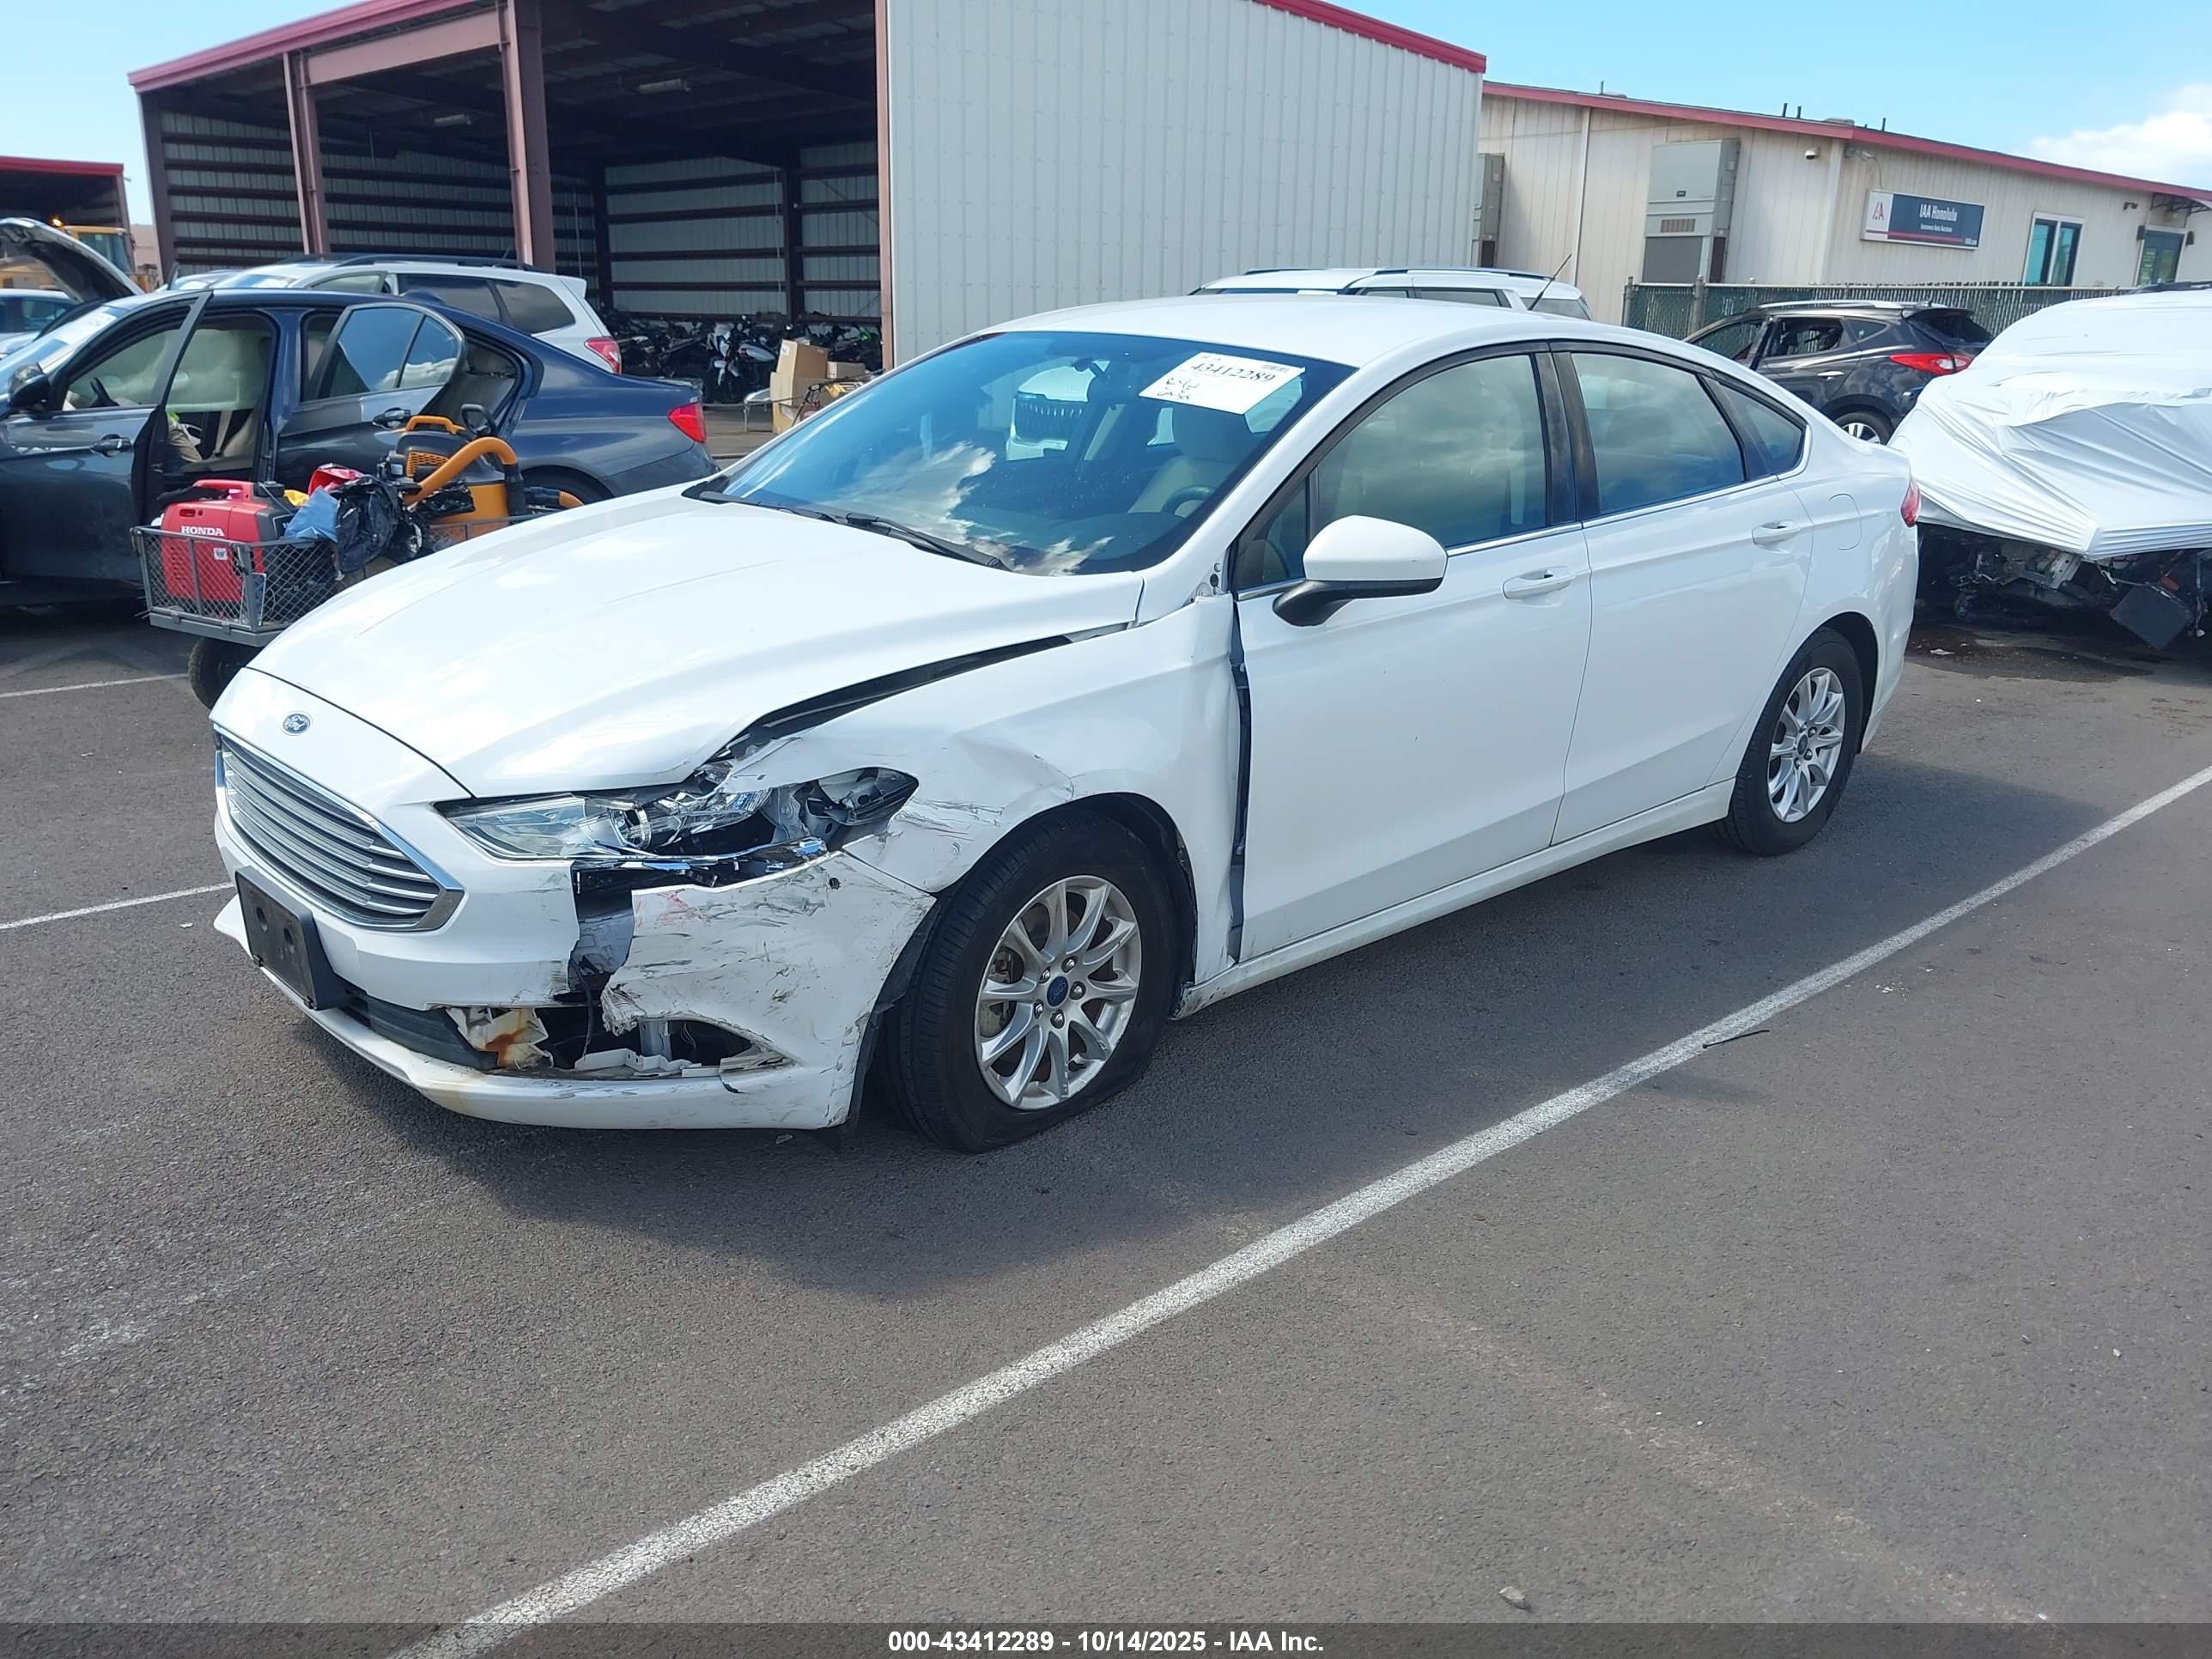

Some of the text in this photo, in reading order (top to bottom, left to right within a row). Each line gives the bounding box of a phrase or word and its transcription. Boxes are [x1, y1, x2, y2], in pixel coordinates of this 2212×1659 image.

[1919, 204, 1931, 218] IAA
[1190, 362, 1276, 382] 43412289
[180, 525, 225, 536] HONDA
